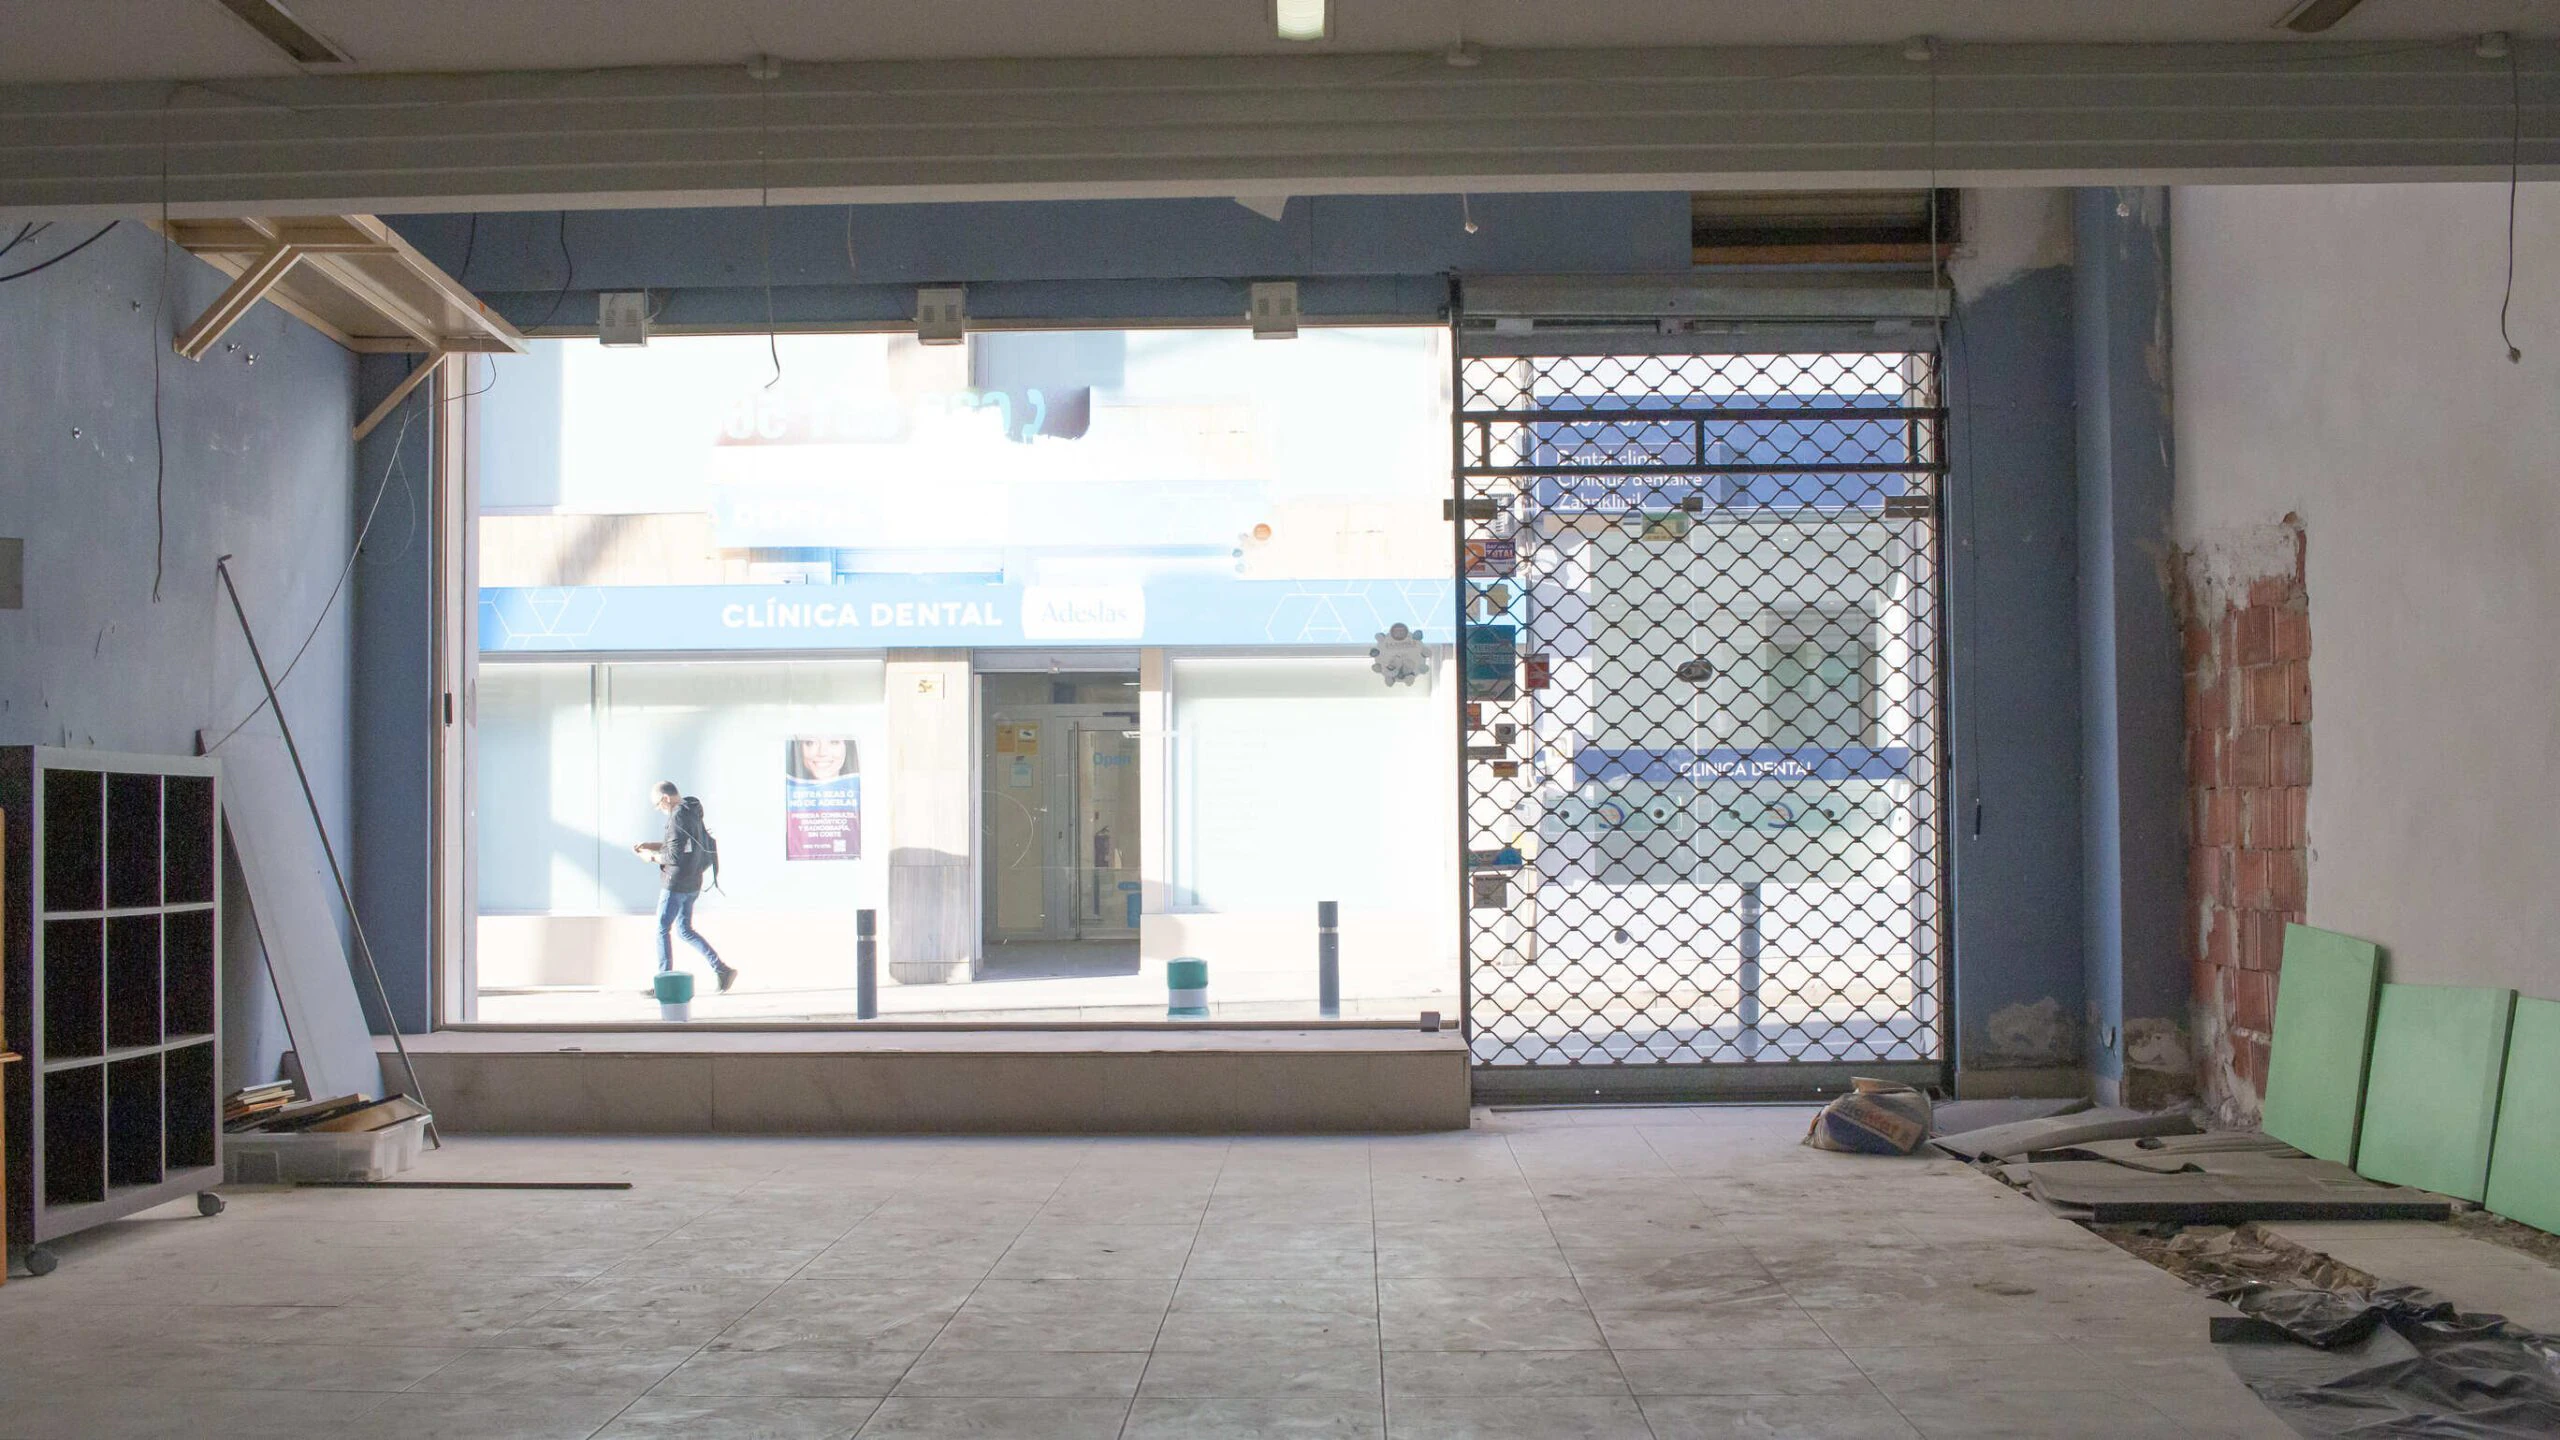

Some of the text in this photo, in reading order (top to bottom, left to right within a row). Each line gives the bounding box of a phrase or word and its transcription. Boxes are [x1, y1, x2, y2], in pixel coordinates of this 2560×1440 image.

[1557, 449, 1614, 465] Dental
[1632, 474, 1703, 487] dentaire
[721, 597, 1128, 627] CLÍNICA DENTAL Adeslas
